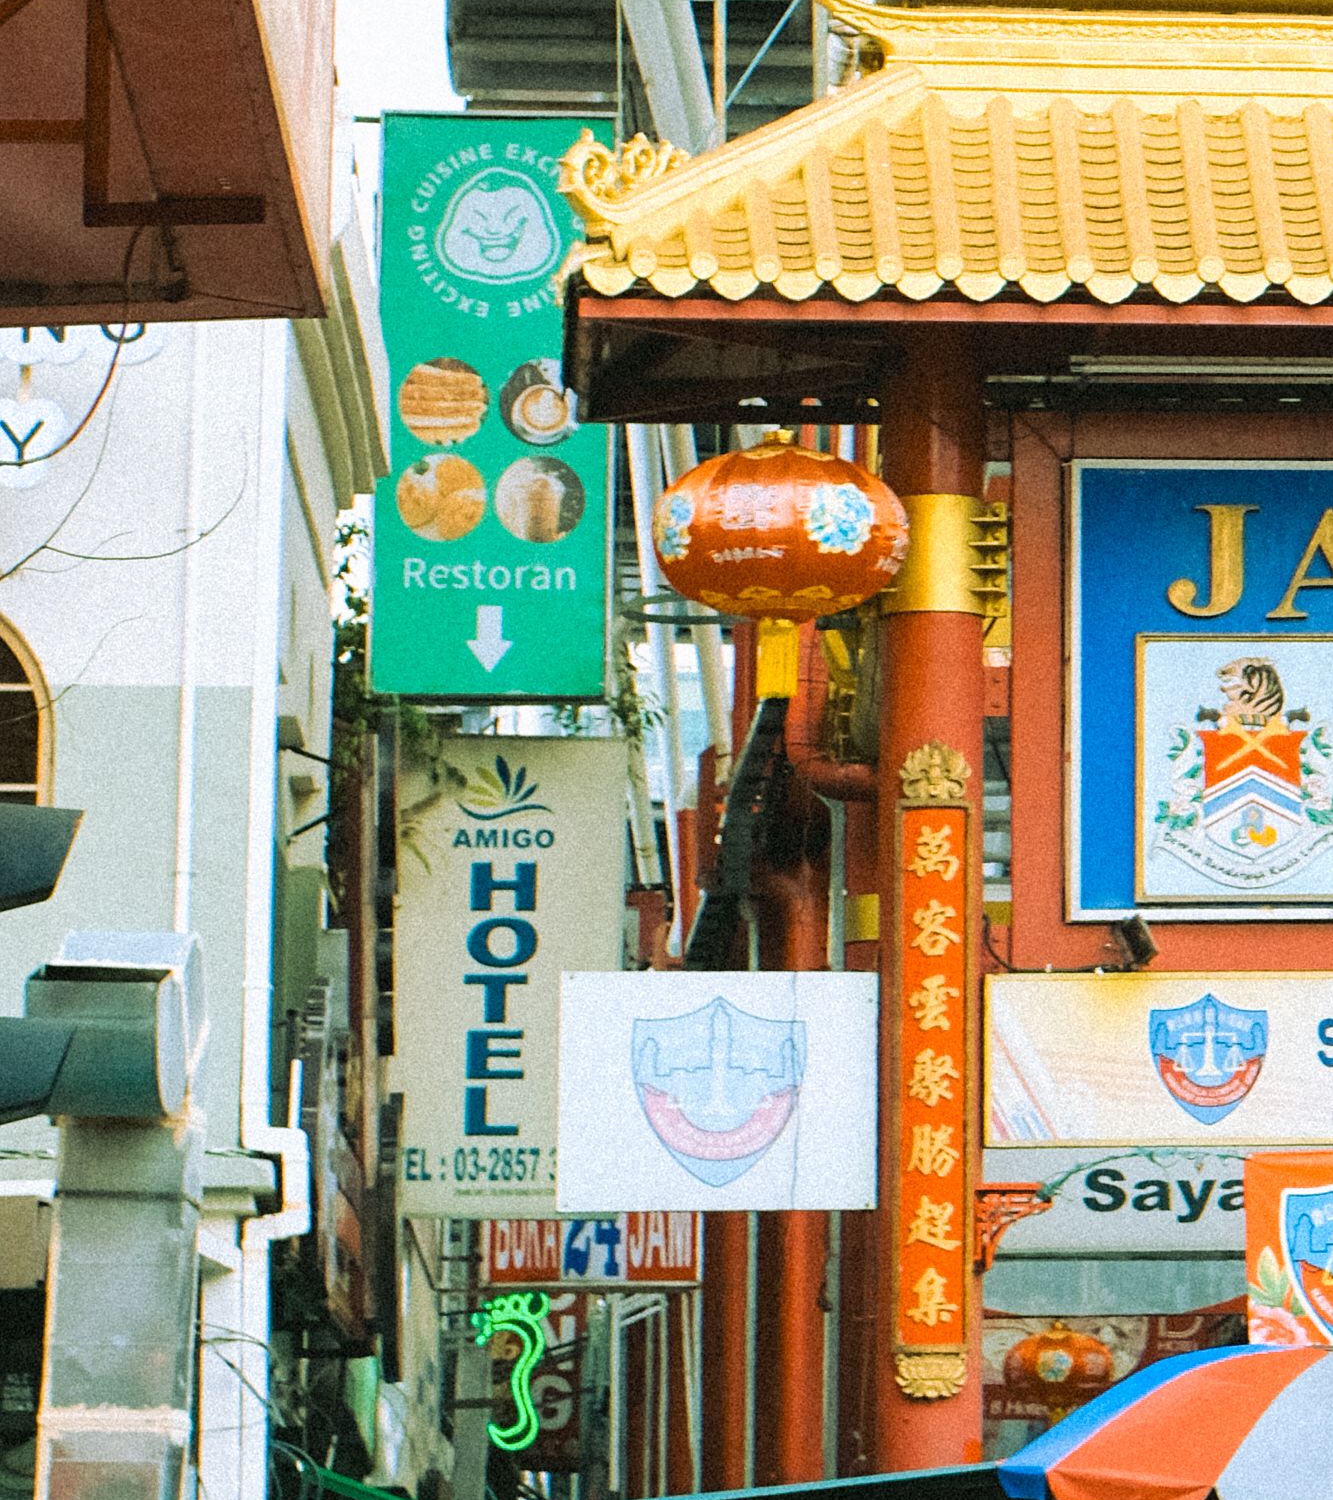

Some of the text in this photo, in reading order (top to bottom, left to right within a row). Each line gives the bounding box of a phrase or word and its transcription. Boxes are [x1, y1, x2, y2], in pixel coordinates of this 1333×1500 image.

[402, 557, 577, 591] Restoran
[452, 828, 556, 851] AMIGO
[462, 861, 540, 1137] HOTEL
[403, 1147, 432, 1182] EL
[453, 1146, 541, 1182] 03-2857
[1083, 1167, 1246, 1224] Saya
